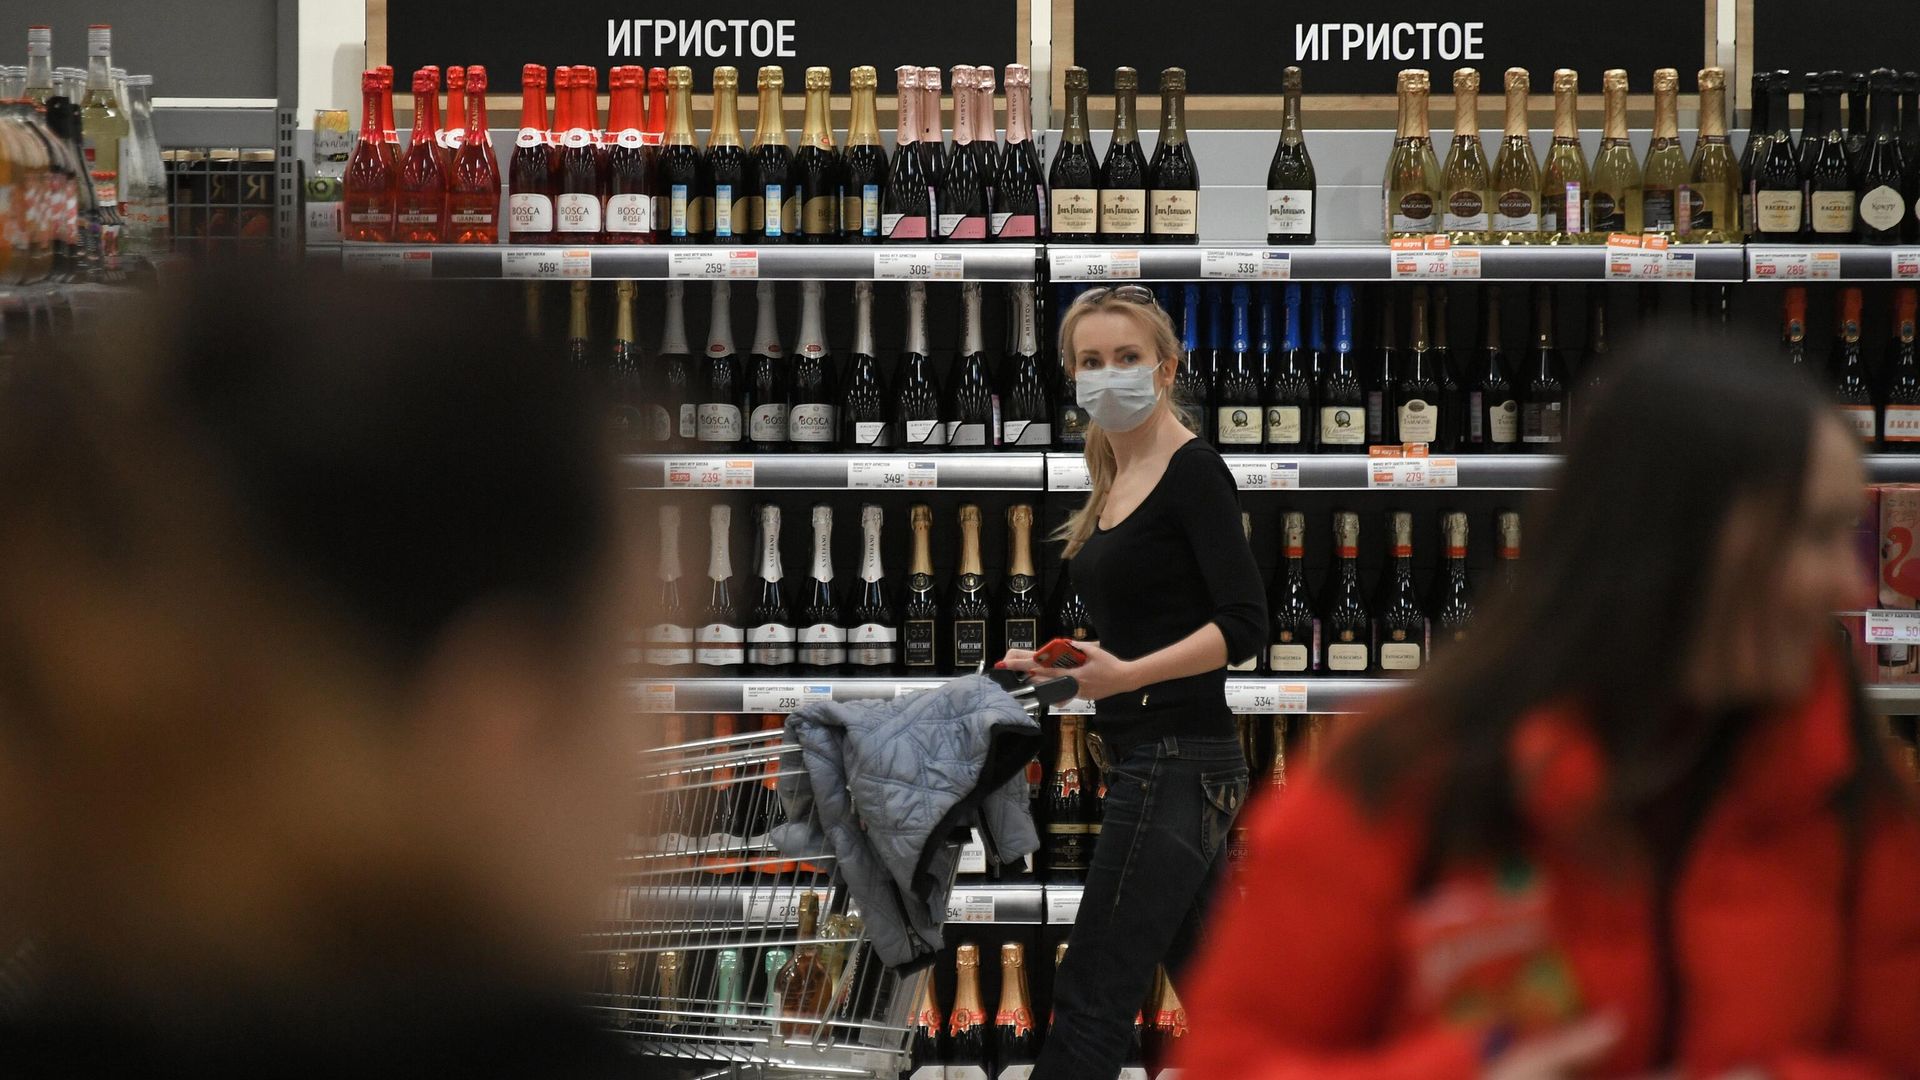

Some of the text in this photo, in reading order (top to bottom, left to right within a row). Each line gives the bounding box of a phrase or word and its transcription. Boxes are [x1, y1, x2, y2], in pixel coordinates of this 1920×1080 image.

[607, 19, 796, 57] ИГРИСТОЕ
[1296, 22, 1484, 60] ИГРИСТОЕ
[511, 206, 540, 215] BOSCA
[560, 206, 589, 215] BOSCA
[617, 207, 646, 216] BOSCA
[538, 262, 555, 273] 369
[705, 263, 722, 273] 259
[909, 264, 927, 275] 309
[1087, 264, 1104, 275] 339
[1237, 263, 1255, 273] 339
[1428, 262, 1445, 273] 279
[1643, 263, 1659, 274] 279
[701, 415, 730, 425] BOSCA
[800, 416, 829, 425] BOSCA
[701, 472, 718, 483] 239
[883, 473, 900, 484] 349
[1246, 474, 1264, 484] 339
[1406, 472, 1421, 482] 279
[779, 697, 796, 708] 239
[1254, 696, 1271, 707] 334
[779, 905, 797, 917] 239
